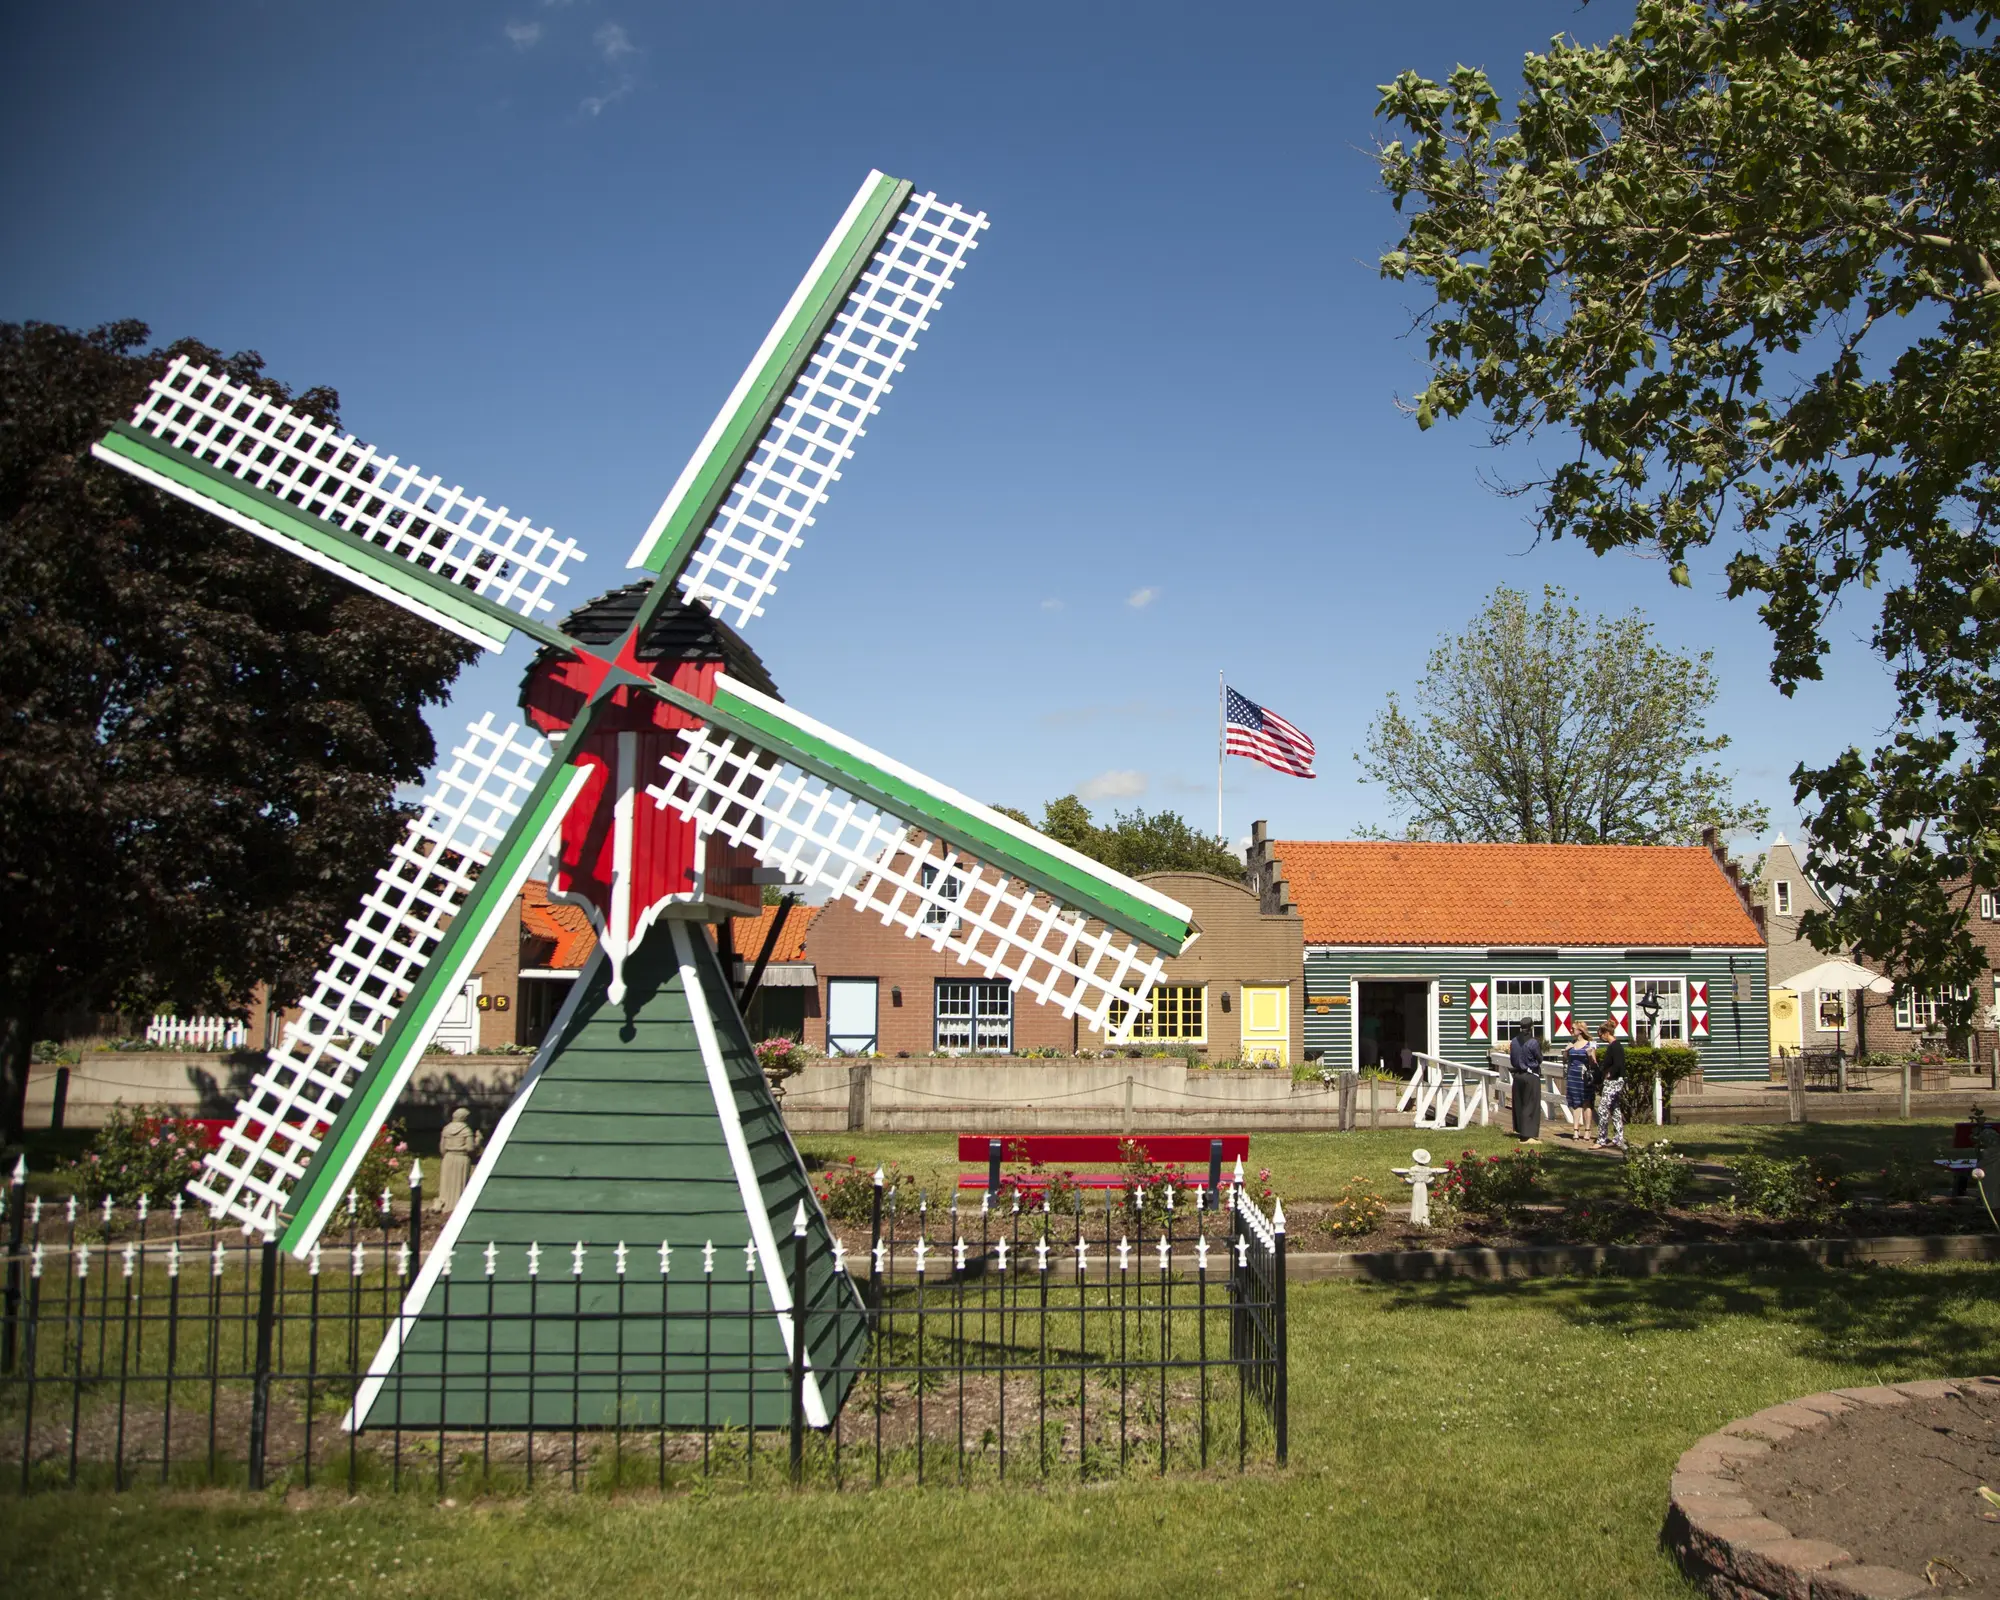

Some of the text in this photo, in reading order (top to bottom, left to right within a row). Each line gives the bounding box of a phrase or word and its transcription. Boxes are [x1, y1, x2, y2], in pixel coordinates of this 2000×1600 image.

[478, 996, 506, 1007] 4 5
[1442, 994, 1450, 1004] 6
